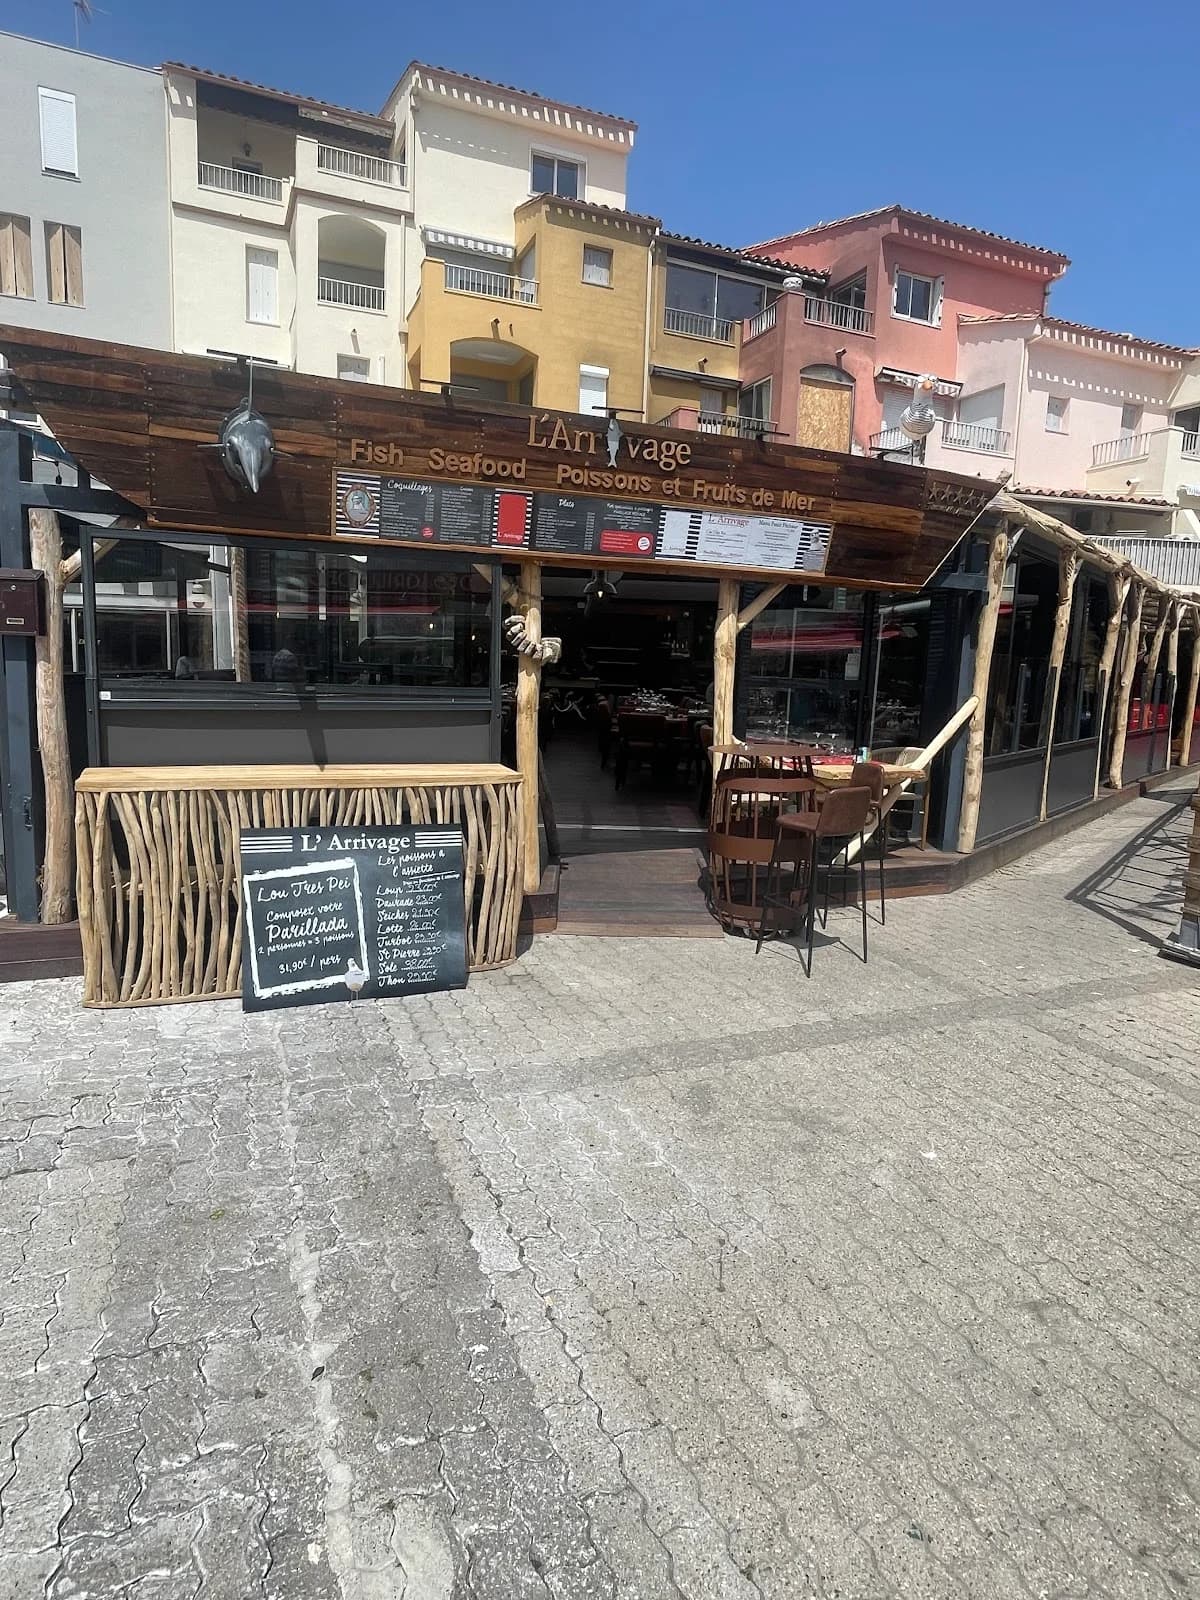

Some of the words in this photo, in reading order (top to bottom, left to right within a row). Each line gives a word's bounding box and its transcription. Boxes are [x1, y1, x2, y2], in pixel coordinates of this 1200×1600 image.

[527, 413, 692, 471] L'Arrvage
[351, 438, 404, 466] Fish
[428, 448, 527, 479] Seafood
[557, 462, 651, 492] Poissons
[662, 477, 681, 496] et
[693, 479, 747, 504] Fruits
[752, 487, 774, 507] de
[783, 490, 816, 511] Mer
[327, 832, 411, 854] Arrivage
[377, 855, 396, 866] Les
[399, 850, 436, 867] poissons
[257, 887, 289, 902] Lou
[326, 876, 351, 892] Pei
[376, 885, 403, 897] Loup
[266, 906, 315, 923] Composez
[317, 902, 344, 913] votre
[377, 909, 410, 922] Seiches
[265, 917, 348, 943] Parillada
[377, 924, 405, 934] Lotte
[257, 946, 265, 954] 2
[267, 939, 306, 956] personnes
[323, 930, 355, 947] poissons
[376, 935, 413, 948] Turbot
[319, 954, 341, 971] pers
[378, 948, 391, 961] St
[392, 948, 420, 959] Pierre
[378, 961, 399, 975] Sole
[377, 975, 405, 987] Thon
